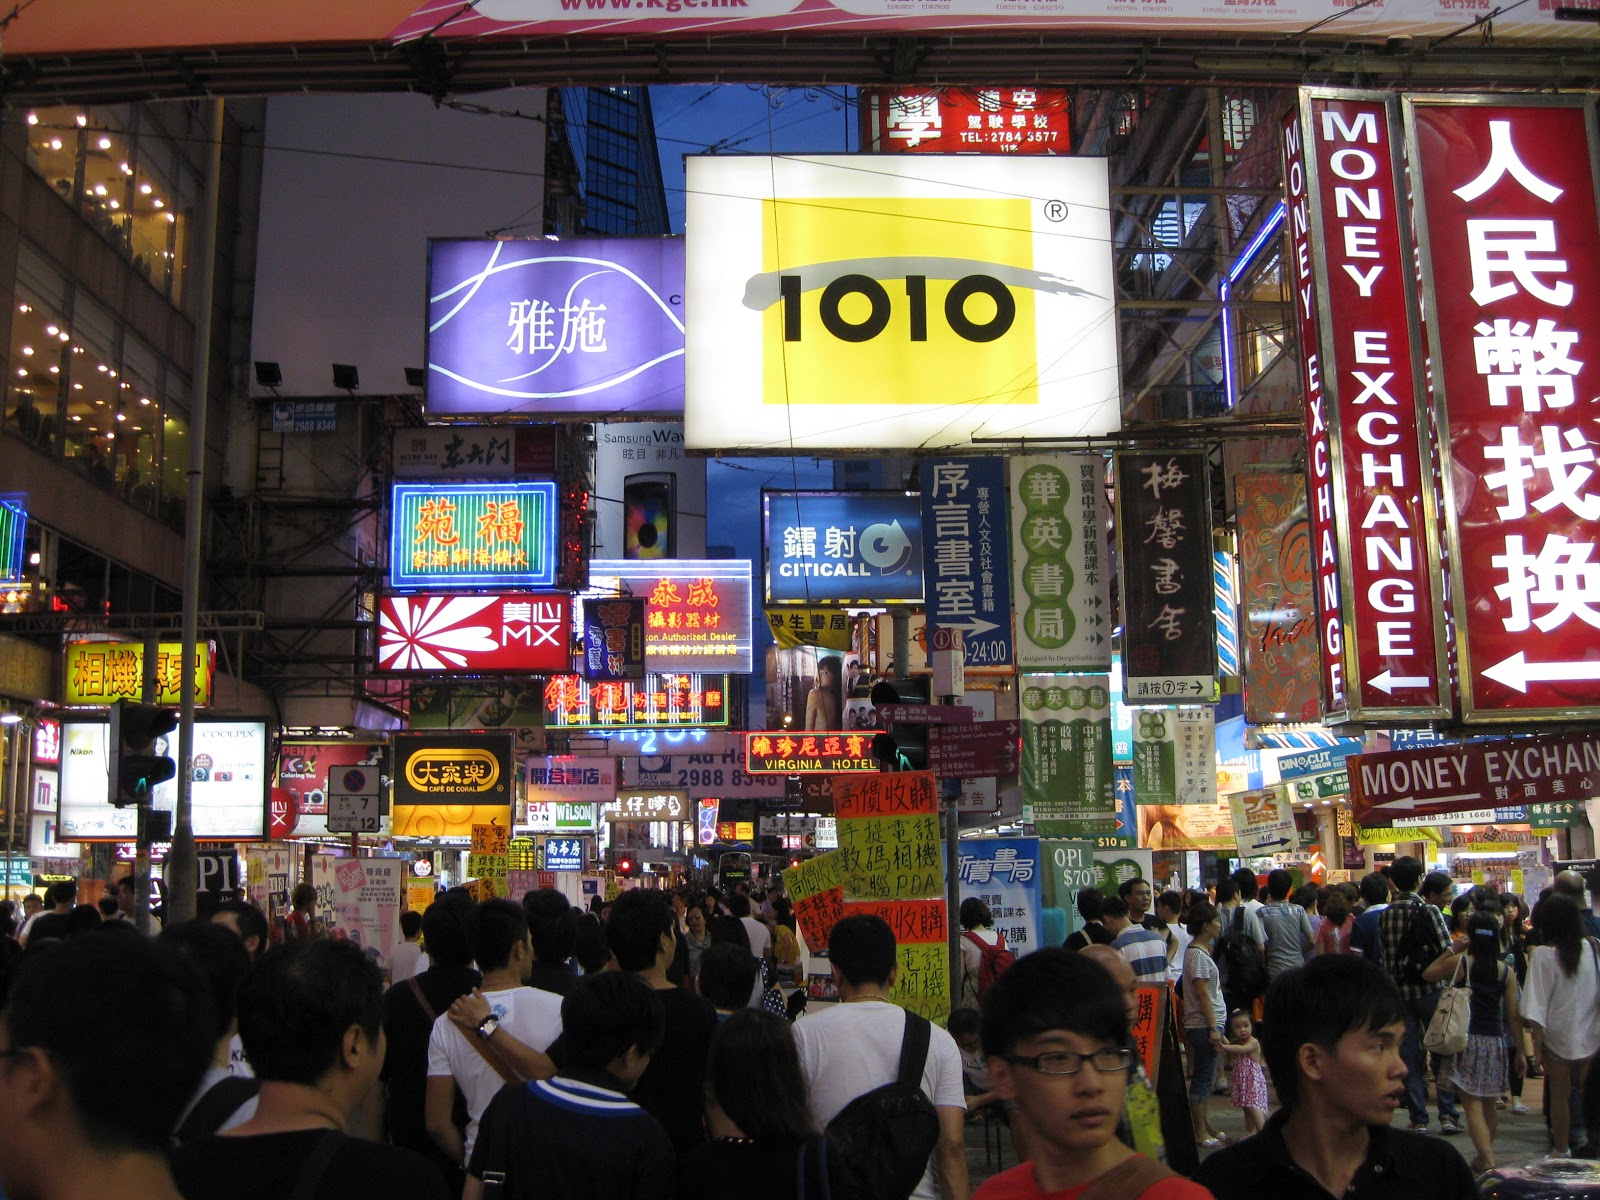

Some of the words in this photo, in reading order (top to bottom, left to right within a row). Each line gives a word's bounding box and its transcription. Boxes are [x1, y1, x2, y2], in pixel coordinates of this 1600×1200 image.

[967, 114, 1048, 130] 駕駛學校
[1321, 110, 1384, 297] MONEY
[1285, 118, 1311, 320] MONEY
[780, 273, 1016, 343] 1010
[507, 298, 608, 356] 雅施
[1452, 120, 1600, 633] 人民幣找換
[604, 432, 652, 447] Samsung
[622, 448, 647, 461] 眩目
[656, 448, 680, 461] 非凡
[1350, 330, 1416, 657] EXCHANGE
[1080, 464, 1100, 587] 買賣中學新舊課本
[1307, 354, 1344, 701] EXCHANGE
[783, 525, 856, 559] 鐳射
[931, 461, 977, 616] 序言書室
[1028, 471, 1065, 641] 華英書局
[779, 562, 871, 577] CITICALL
[649, 576, 719, 608] 永成
[502, 602, 562, 624] 美心
[647, 611, 722, 630] 攝影器材
[502, 625, 560, 647] MX
[661, 632, 706, 644] Authorized
[709, 632, 737, 644] Dealer
[1025, 689, 1105, 706] 華英書局
[202, 729, 255, 739] COOLPIX
[70, 748, 93, 756] Nikon
[751, 736, 873, 757] 維珍尼亞賓
[764, 759, 823, 770] VIRGINIA
[832, 759, 877, 770] HOTEL
[1082, 725, 1097, 803] 中學新舊課本
[280, 772, 305, 781] Coloring
[305, 772, 317, 780] You
[638, 773, 658, 784] EASY
[678, 768, 724, 787] 2988
[1361, 754, 1469, 796] MONEY
[446, 785, 455, 793] DE
[455, 785, 478, 793] CORAL
[835, 776, 935, 813] 高價收購
[1117, 779, 1132, 793] 本
[1494, 776, 1593, 801] 對面美心
[361, 798, 369, 810] 7
[360, 817, 376, 830] 12
[1443, 812, 1466, 820] 2391
[1468, 810, 1492, 818] 1666
[839, 818, 936, 845] 手提電話
[1098, 837, 1117, 848] $10
[840, 846, 940, 873] 數碼相機
[1054, 848, 1084, 868] OPI
[1572, 863, 1590, 871] iPhone
[1063, 869, 1091, 886] $70
